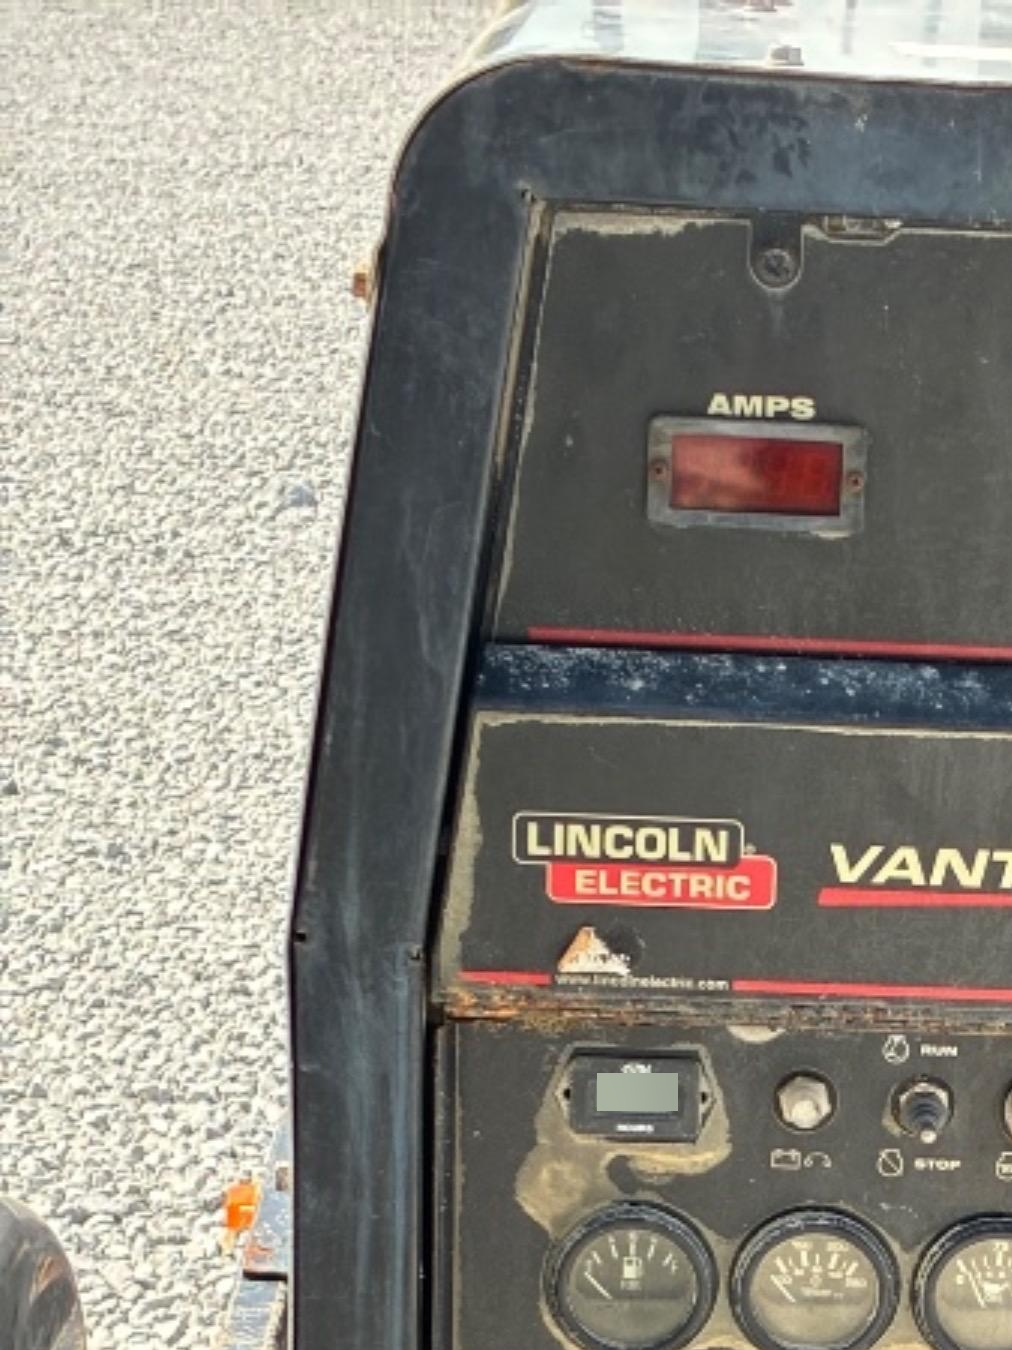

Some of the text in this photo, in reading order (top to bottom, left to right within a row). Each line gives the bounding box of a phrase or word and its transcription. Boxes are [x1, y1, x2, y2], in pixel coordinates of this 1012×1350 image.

[706, 392, 816, 421] AMPS
[526, 820, 729, 862] LINCOLN
[574, 868, 752, 899] ELECTRIC
[921, 1044, 958, 1056] RUN
[914, 1157, 961, 1170] STOP
